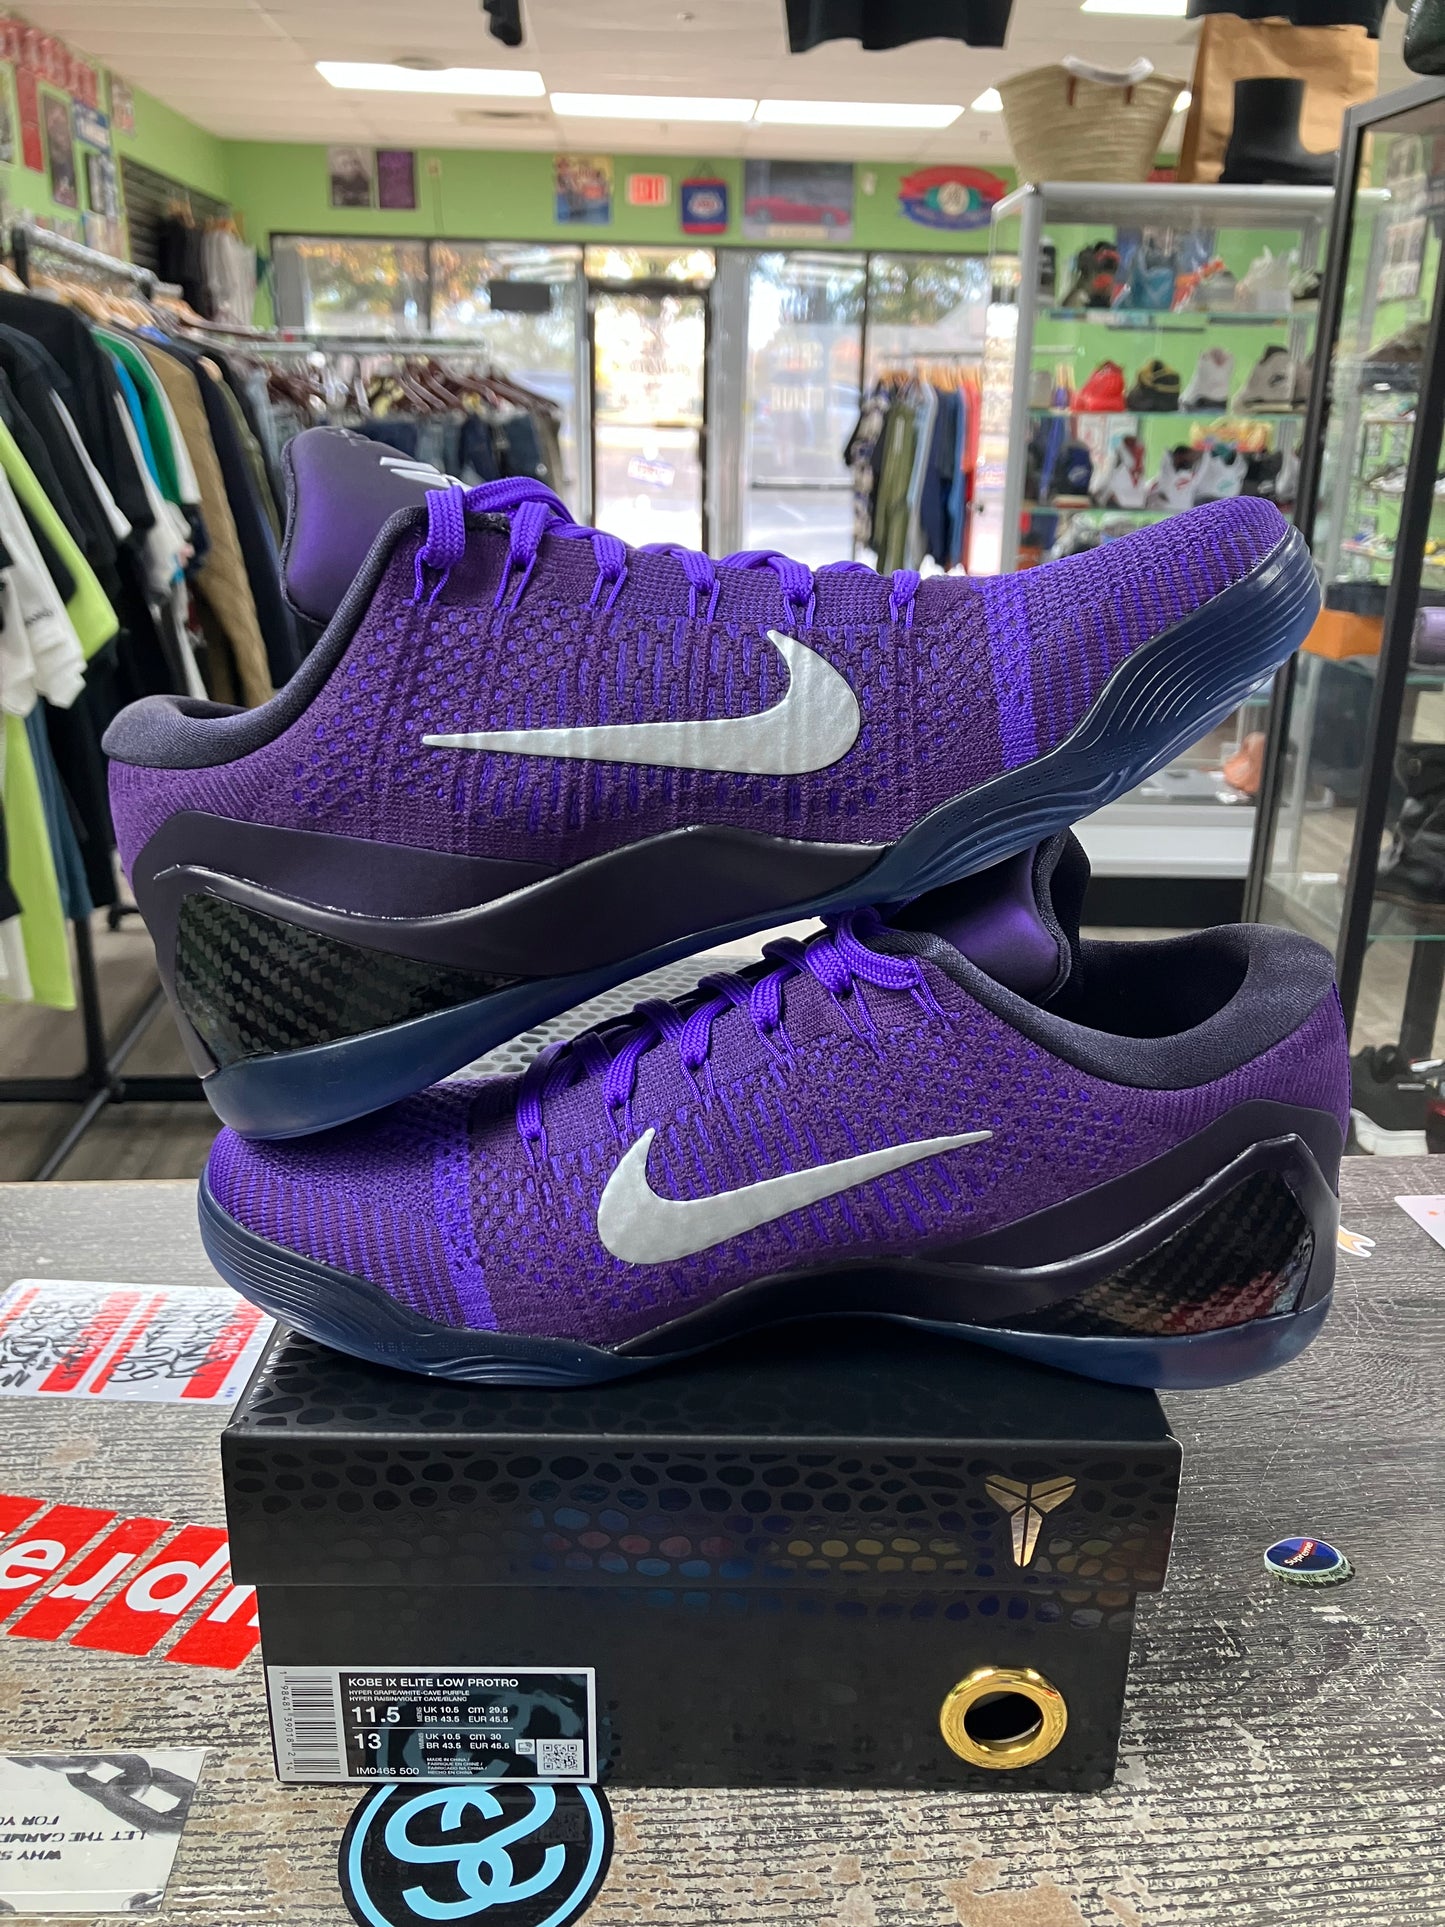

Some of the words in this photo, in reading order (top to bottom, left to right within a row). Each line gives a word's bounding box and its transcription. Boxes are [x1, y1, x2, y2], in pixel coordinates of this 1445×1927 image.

[1284, 1541, 1314, 1566] Supreme
[348, 1678, 382, 1687] KOBE
[386, 1678, 397, 1687] IX
[400, 1678, 434, 1687] ELITE
[437, 1678, 464, 1687] LOW
[468, 1678, 519, 1687] PROTRO
[281, 1685, 291, 1711] 98481
[351, 1706, 401, 1723] 11.5
[423, 1706, 437, 1714] UK
[440, 1706, 460, 1714] 10.5
[467, 1706, 485, 1714] cm
[424, 1715, 438, 1723] BR
[440, 1715, 460, 1723] 43.5
[468, 1715, 487, 1723] EUR
[489, 1715, 509, 1723] 45.5
[284, 1718, 294, 1743] 39018
[353, 1733, 382, 1750] 13
[425, 1733, 439, 1741] UK
[442, 1733, 461, 1741] 10.5
[469, 1733, 486, 1741] cm
[490, 1733, 502, 1741] 30
[426, 1742, 440, 1750] BR
[442, 1742, 462, 1750] 43.5
[469, 1742, 489, 1750] EUR
[490, 1742, 510, 1750] 45.5
[356, 1767, 396, 1775] IM0465
[399, 1767, 420, 1775] 500
[22, 1816, 59, 1825] FOR
[68, 1832, 104, 1842] THE
[110, 1831, 147, 1841] LET
[17, 1850, 61, 1860] WHY
